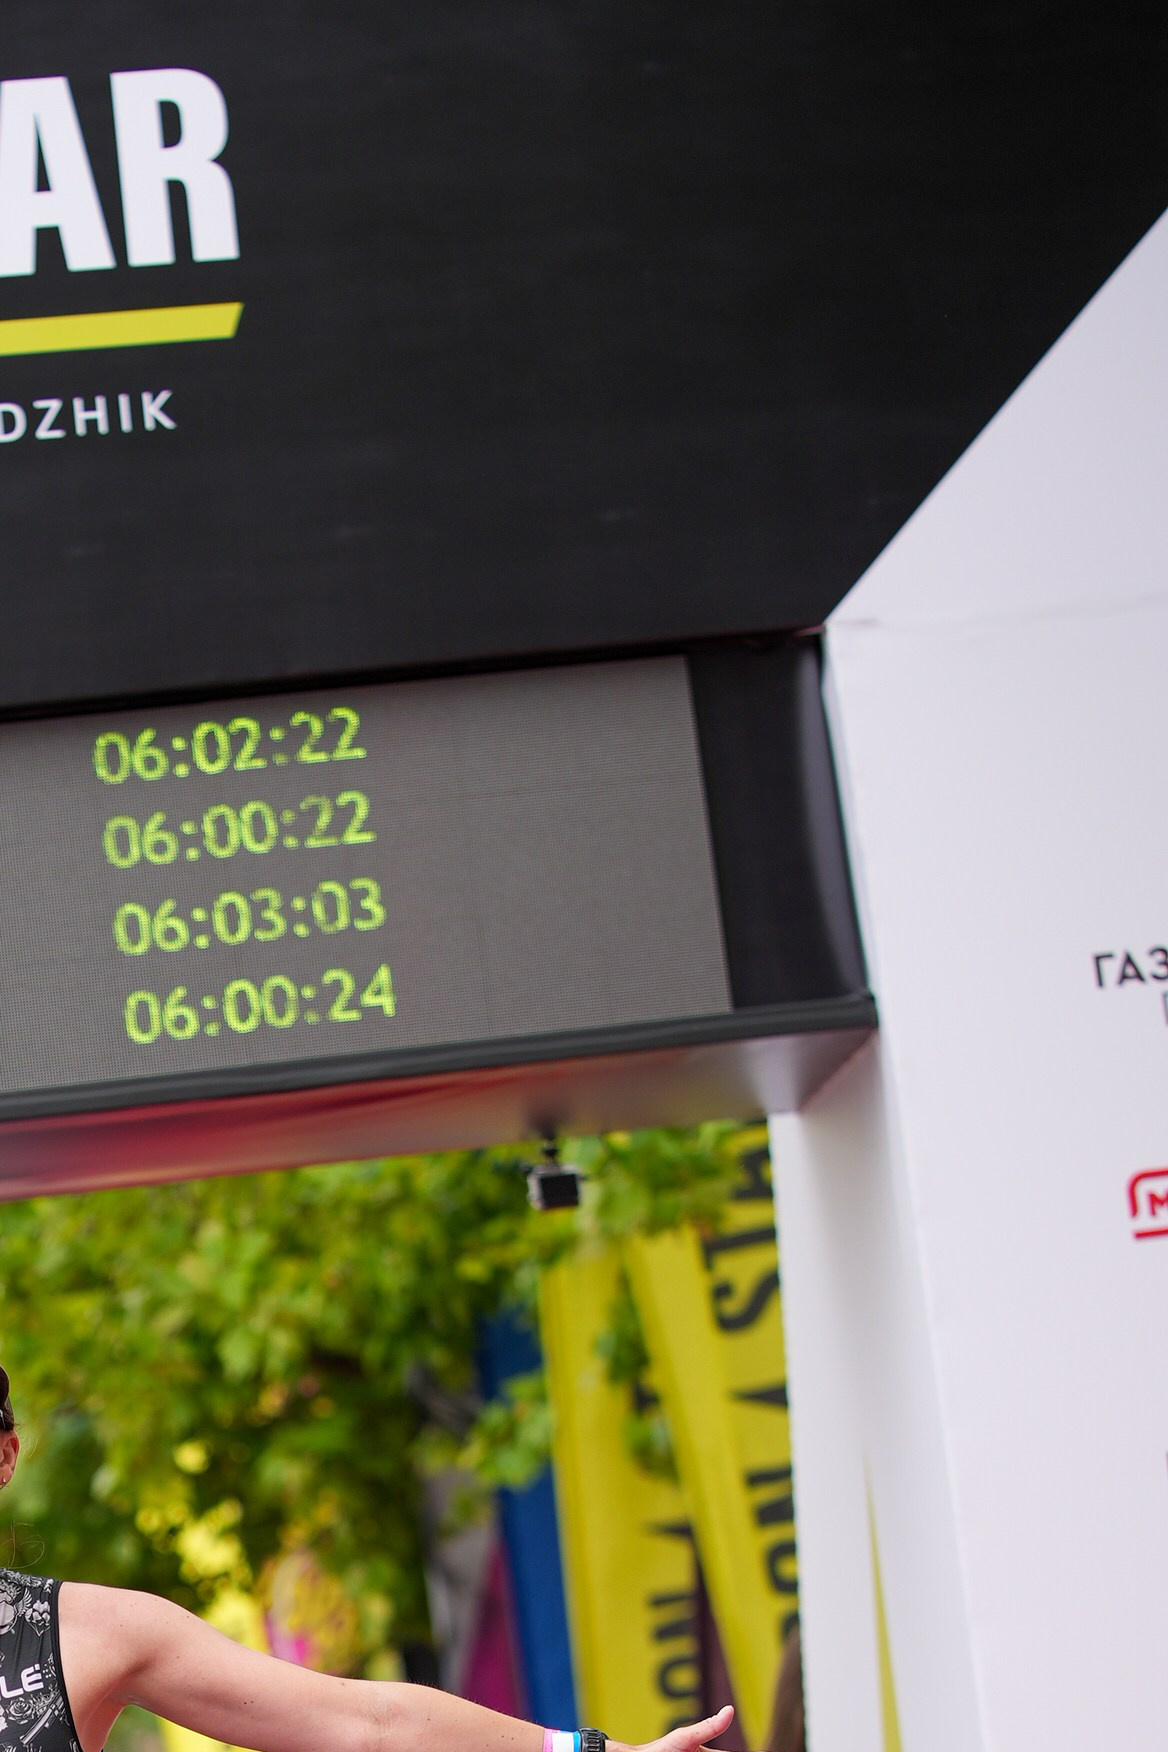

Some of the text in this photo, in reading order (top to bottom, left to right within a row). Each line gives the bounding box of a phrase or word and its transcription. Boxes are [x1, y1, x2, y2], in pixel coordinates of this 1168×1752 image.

[93, 707, 367, 784] 06:02:22
[102, 791, 376, 868] 06:00:22
[113, 877, 387, 955] 06:03:03
[124, 963, 397, 1044] 06:00:24
